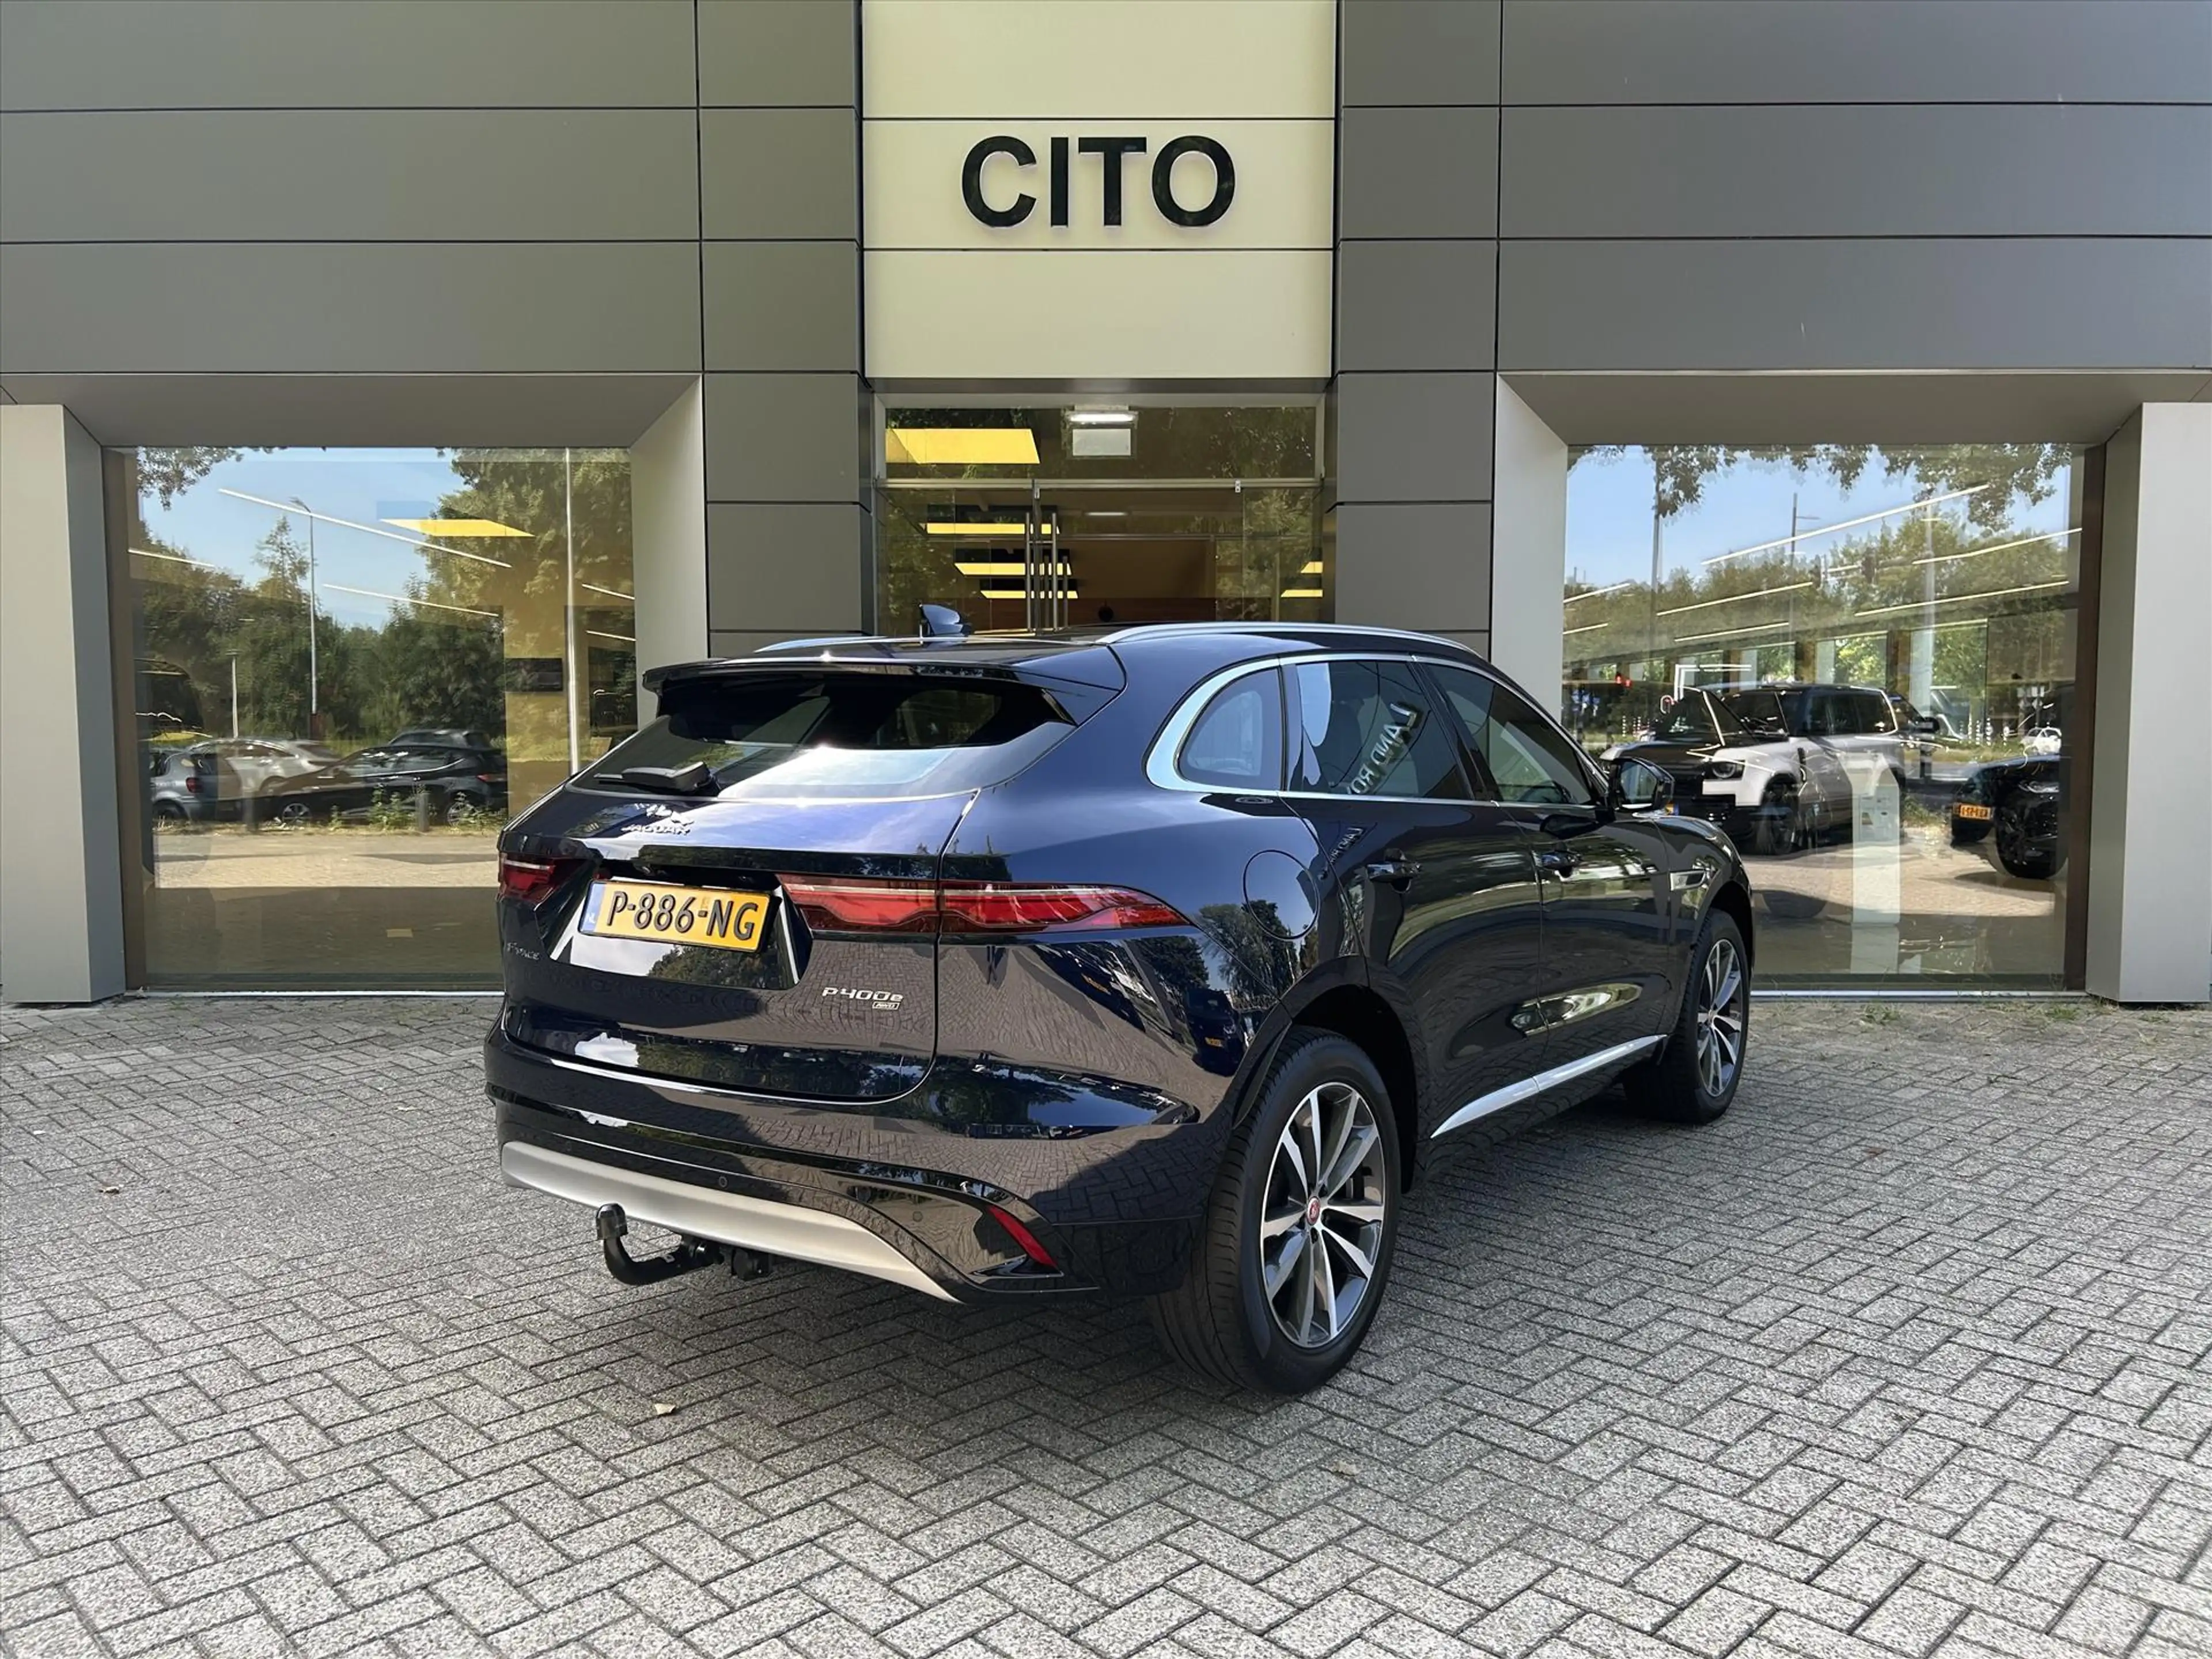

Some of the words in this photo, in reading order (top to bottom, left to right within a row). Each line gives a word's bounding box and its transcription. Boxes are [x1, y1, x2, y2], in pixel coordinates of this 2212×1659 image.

[961, 135, 1236, 227] CITO
[607, 891, 759, 941] P-886-NG
[822, 987, 903, 1001] P400e
